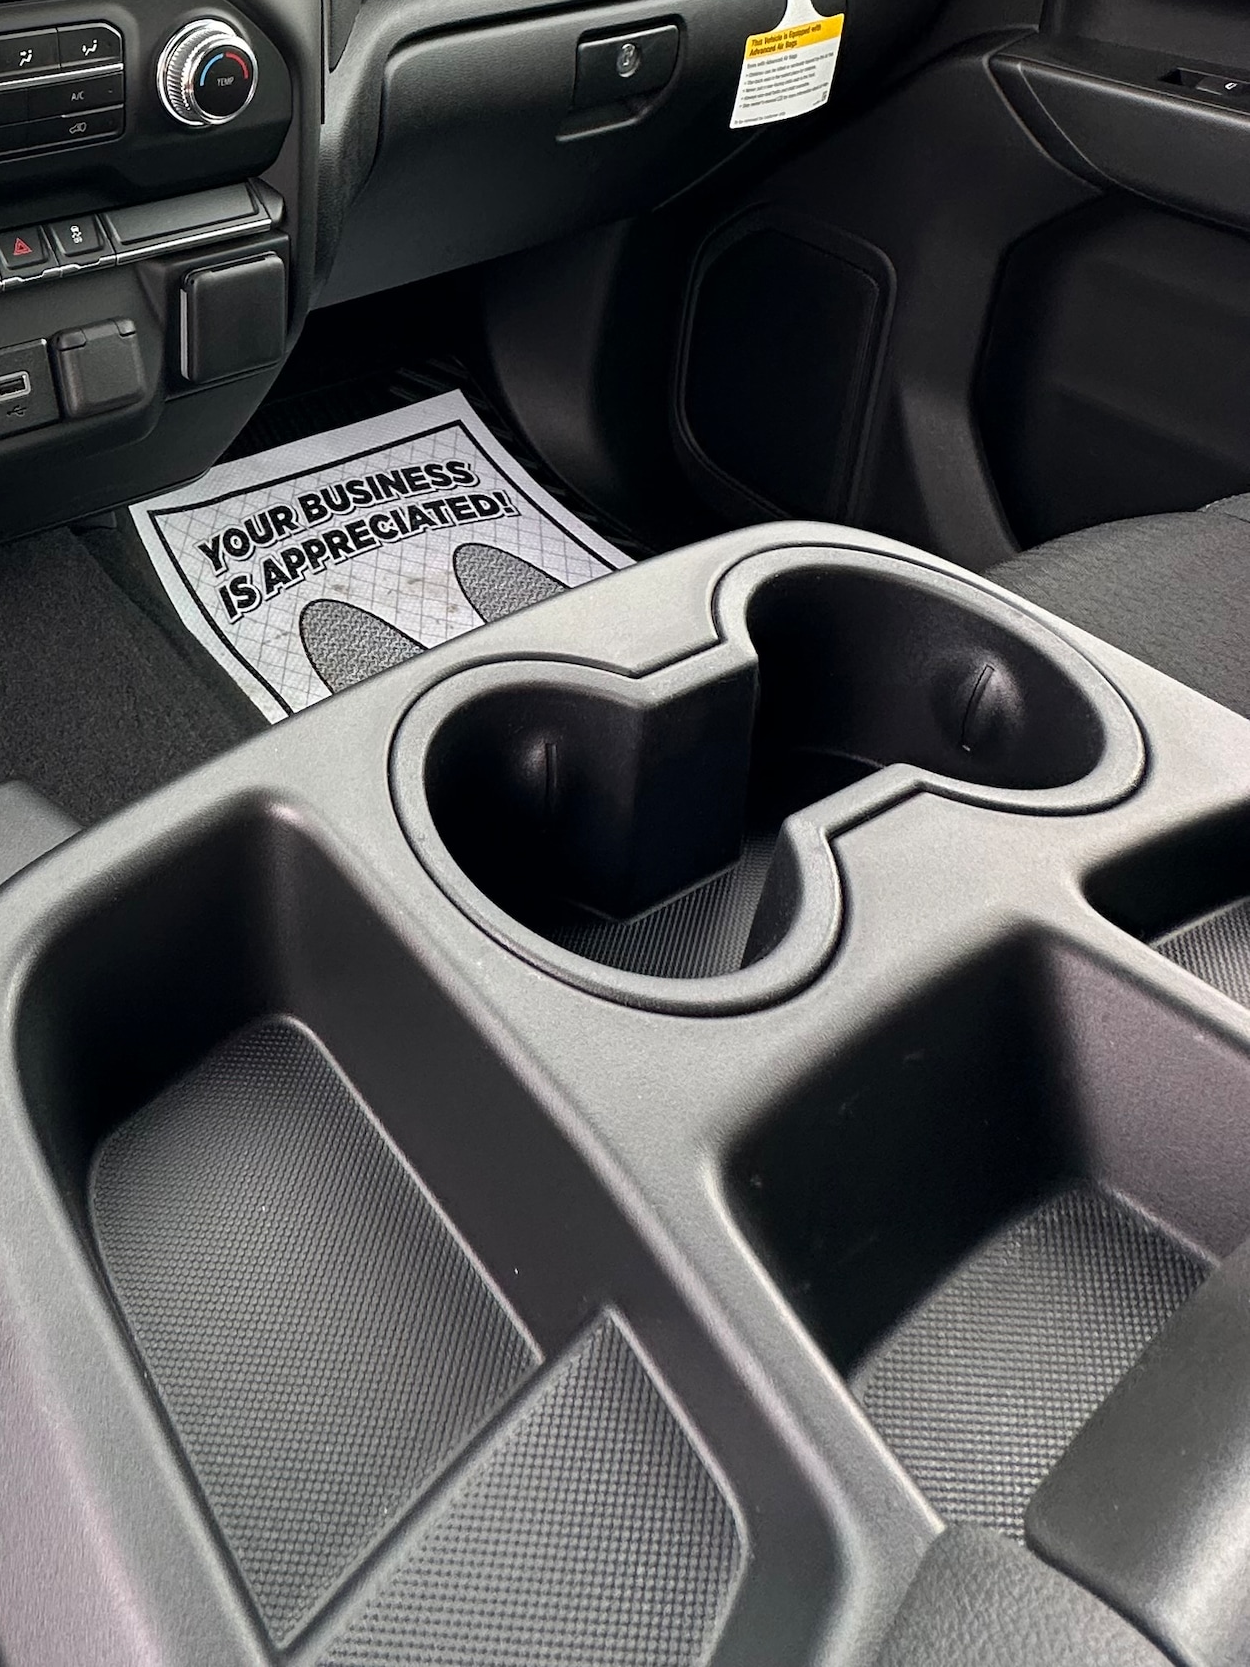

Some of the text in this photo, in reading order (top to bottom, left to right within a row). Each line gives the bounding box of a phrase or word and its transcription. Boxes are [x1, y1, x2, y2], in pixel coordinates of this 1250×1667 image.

[71, 91, 84, 101] A/C
[216, 77, 235, 87] TEMP
[198, 460, 480, 575] YOUR BUSINESS
[218, 491, 520, 621] IS APPRECIATED!
